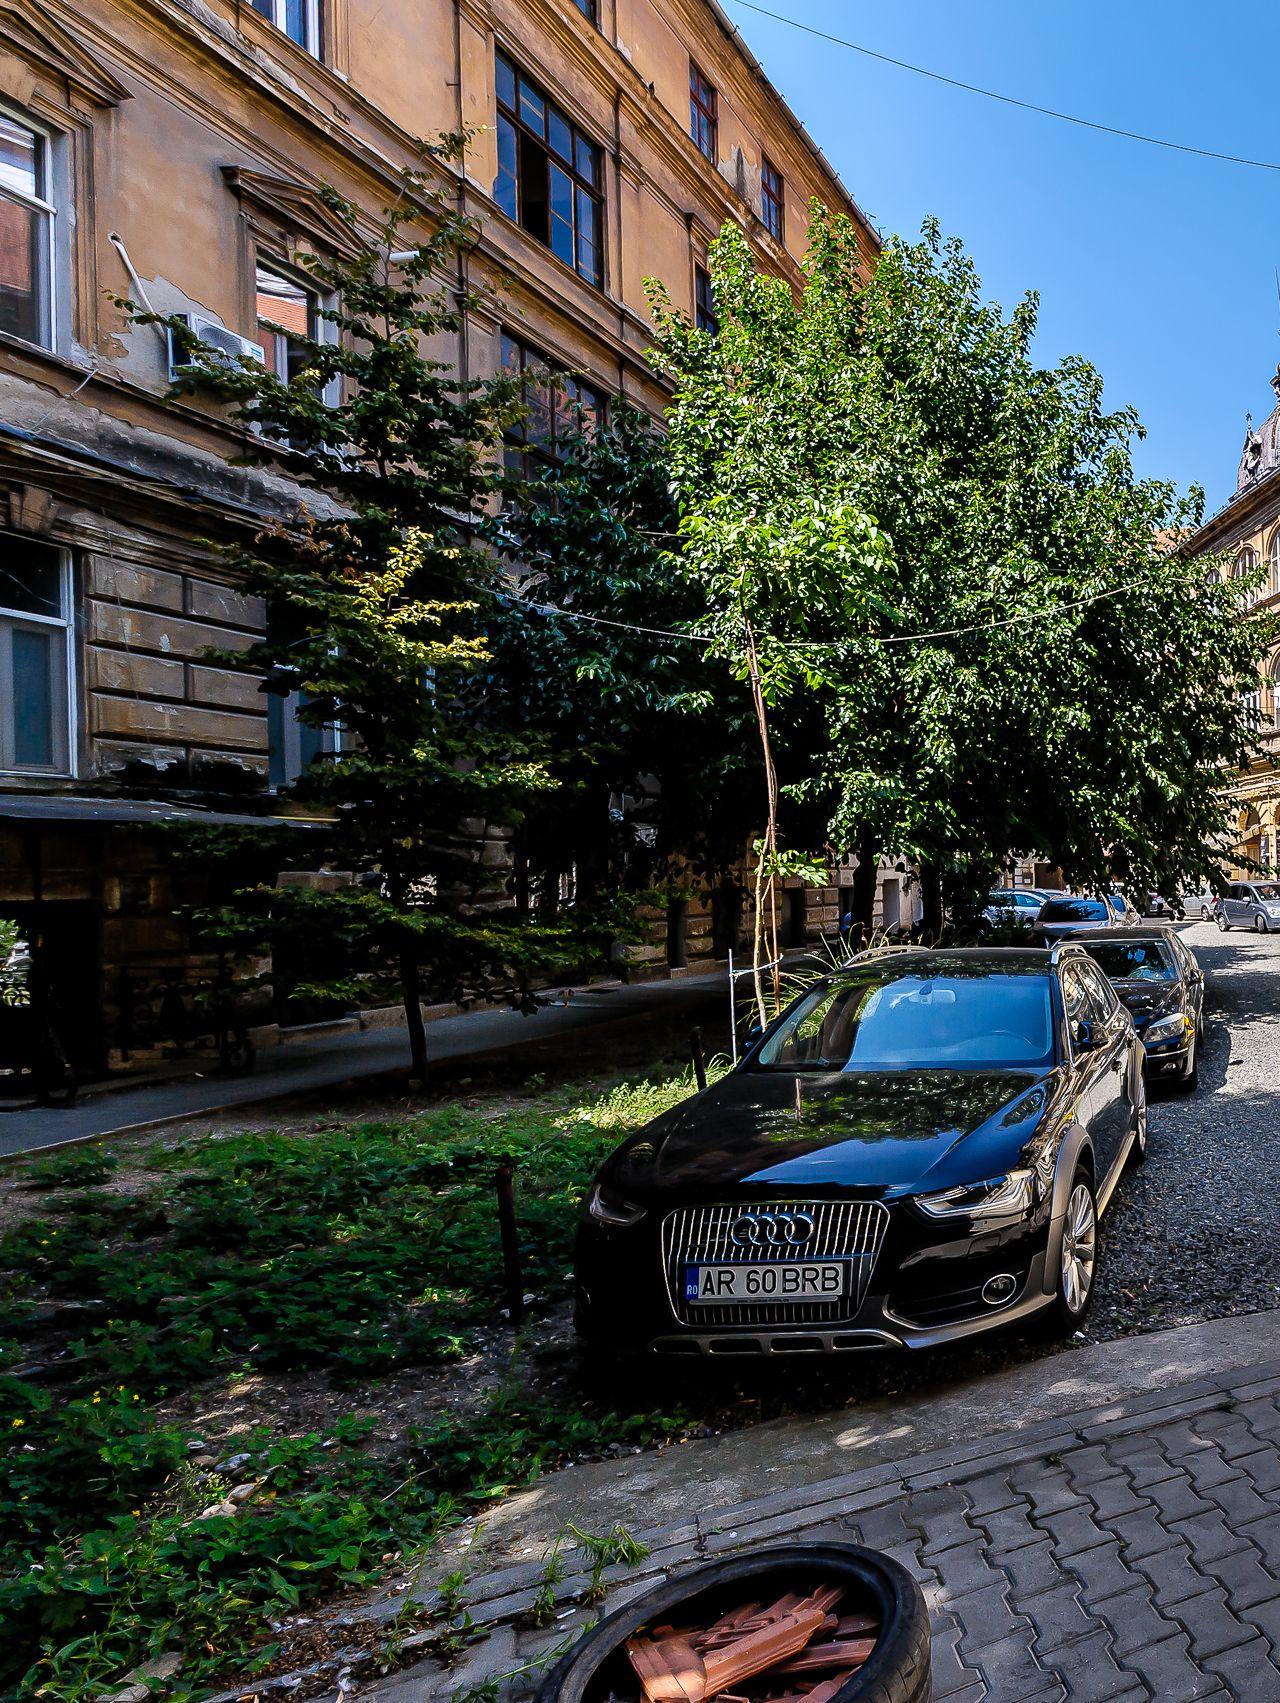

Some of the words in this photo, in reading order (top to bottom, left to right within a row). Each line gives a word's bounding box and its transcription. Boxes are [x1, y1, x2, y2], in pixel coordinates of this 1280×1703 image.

[687, 1284, 698, 1295] RO
[702, 1269, 735, 1295] AR
[746, 1268, 777, 1294] 60
[782, 1266, 840, 1293] BRB
